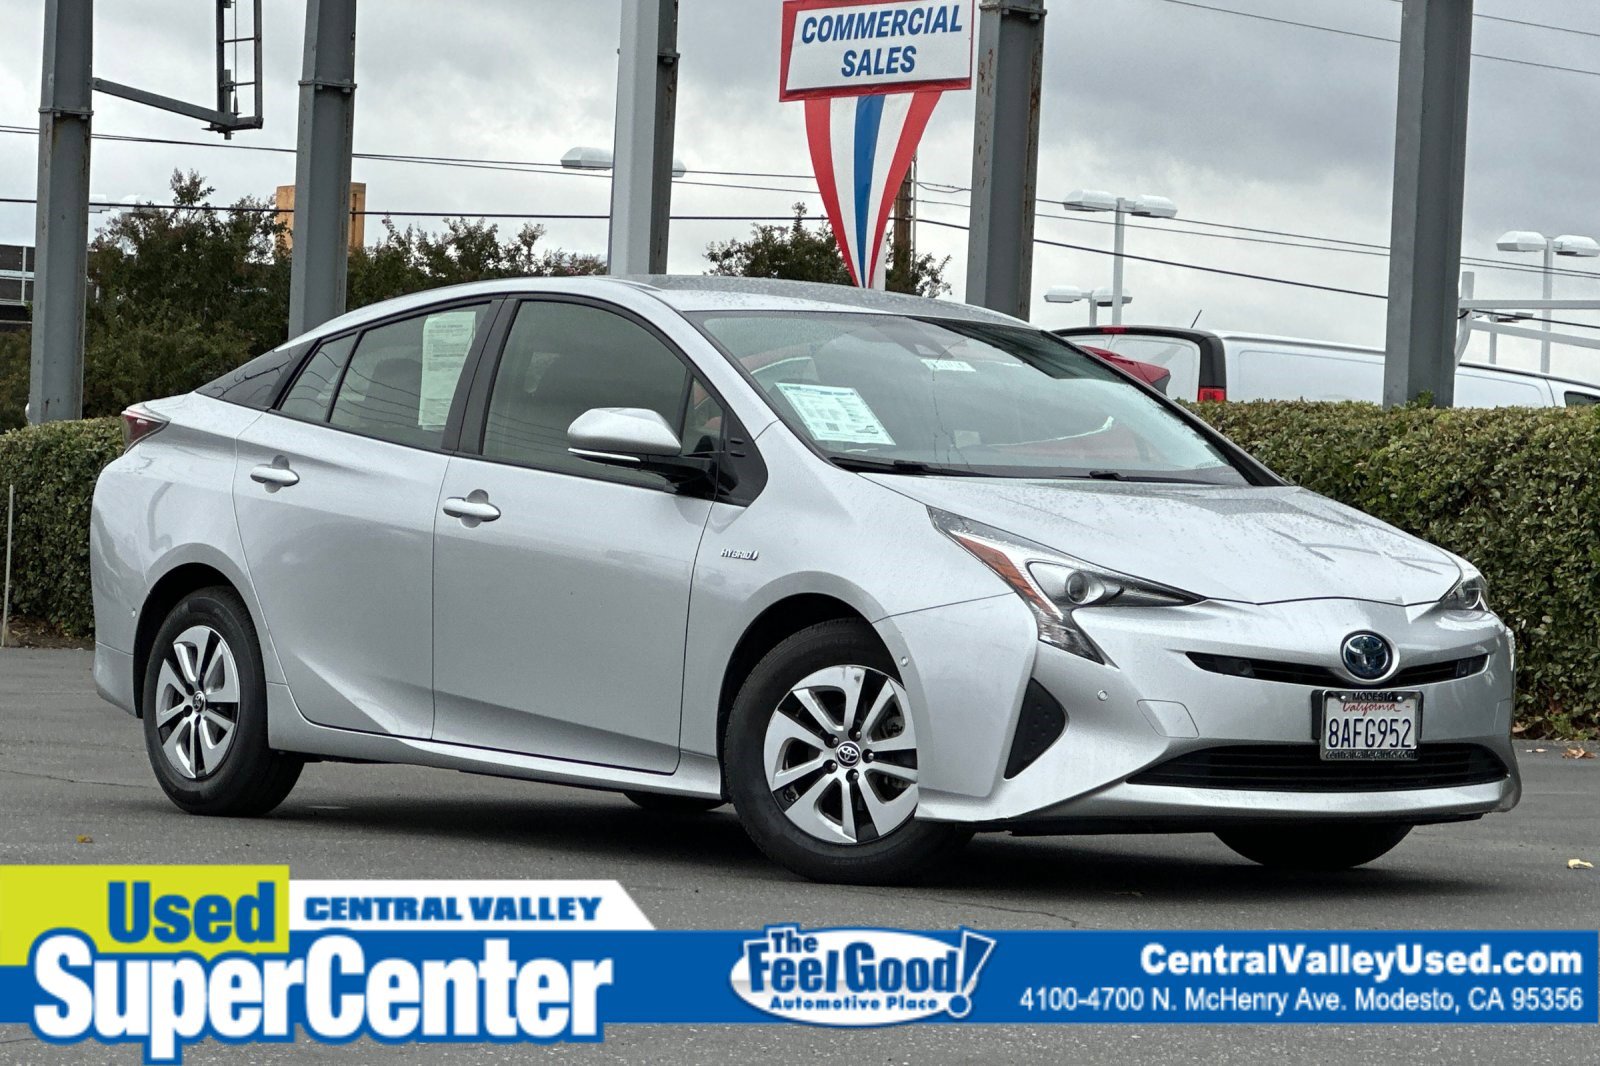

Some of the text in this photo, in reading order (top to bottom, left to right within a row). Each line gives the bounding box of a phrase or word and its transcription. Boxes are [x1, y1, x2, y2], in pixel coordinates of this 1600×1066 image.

[802, 5, 963, 44] COMMERCIAL
[841, 45, 917, 78] SALES
[1342, 701, 1402, 717] California
[1351, 692, 1393, 701] MODESTO
[1328, 718, 1412, 748] 8AFG952
